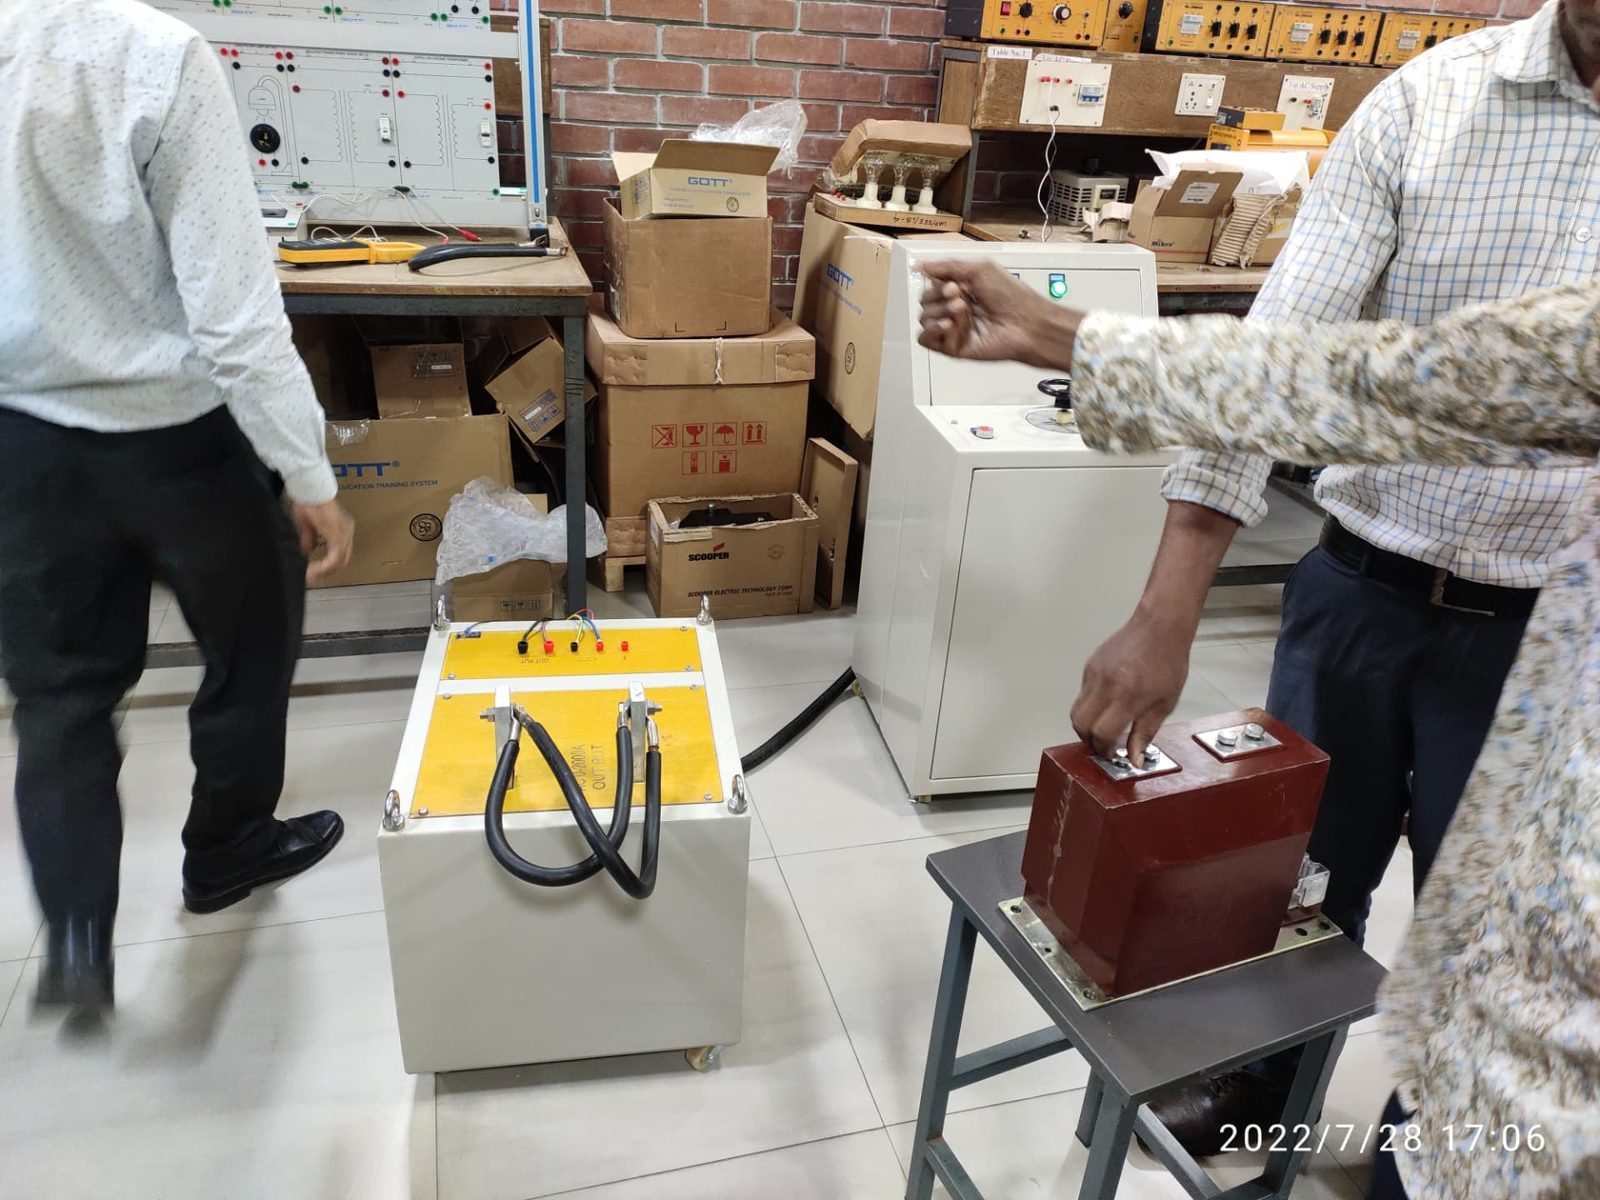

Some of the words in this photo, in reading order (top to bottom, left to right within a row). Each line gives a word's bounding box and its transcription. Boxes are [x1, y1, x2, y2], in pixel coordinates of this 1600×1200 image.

[688, 176, 729, 188] GOTT
[827, 263, 853, 291] GOTT
[332, 462, 391, 477] OTT
[338, 483, 375, 491] DUCATION
[376, 482, 409, 490] TRAINING
[409, 480, 438, 488] SYSTEM
[688, 552, 730, 561] SCOOPER
[741, 586, 776, 594] TECHNOLOGY
